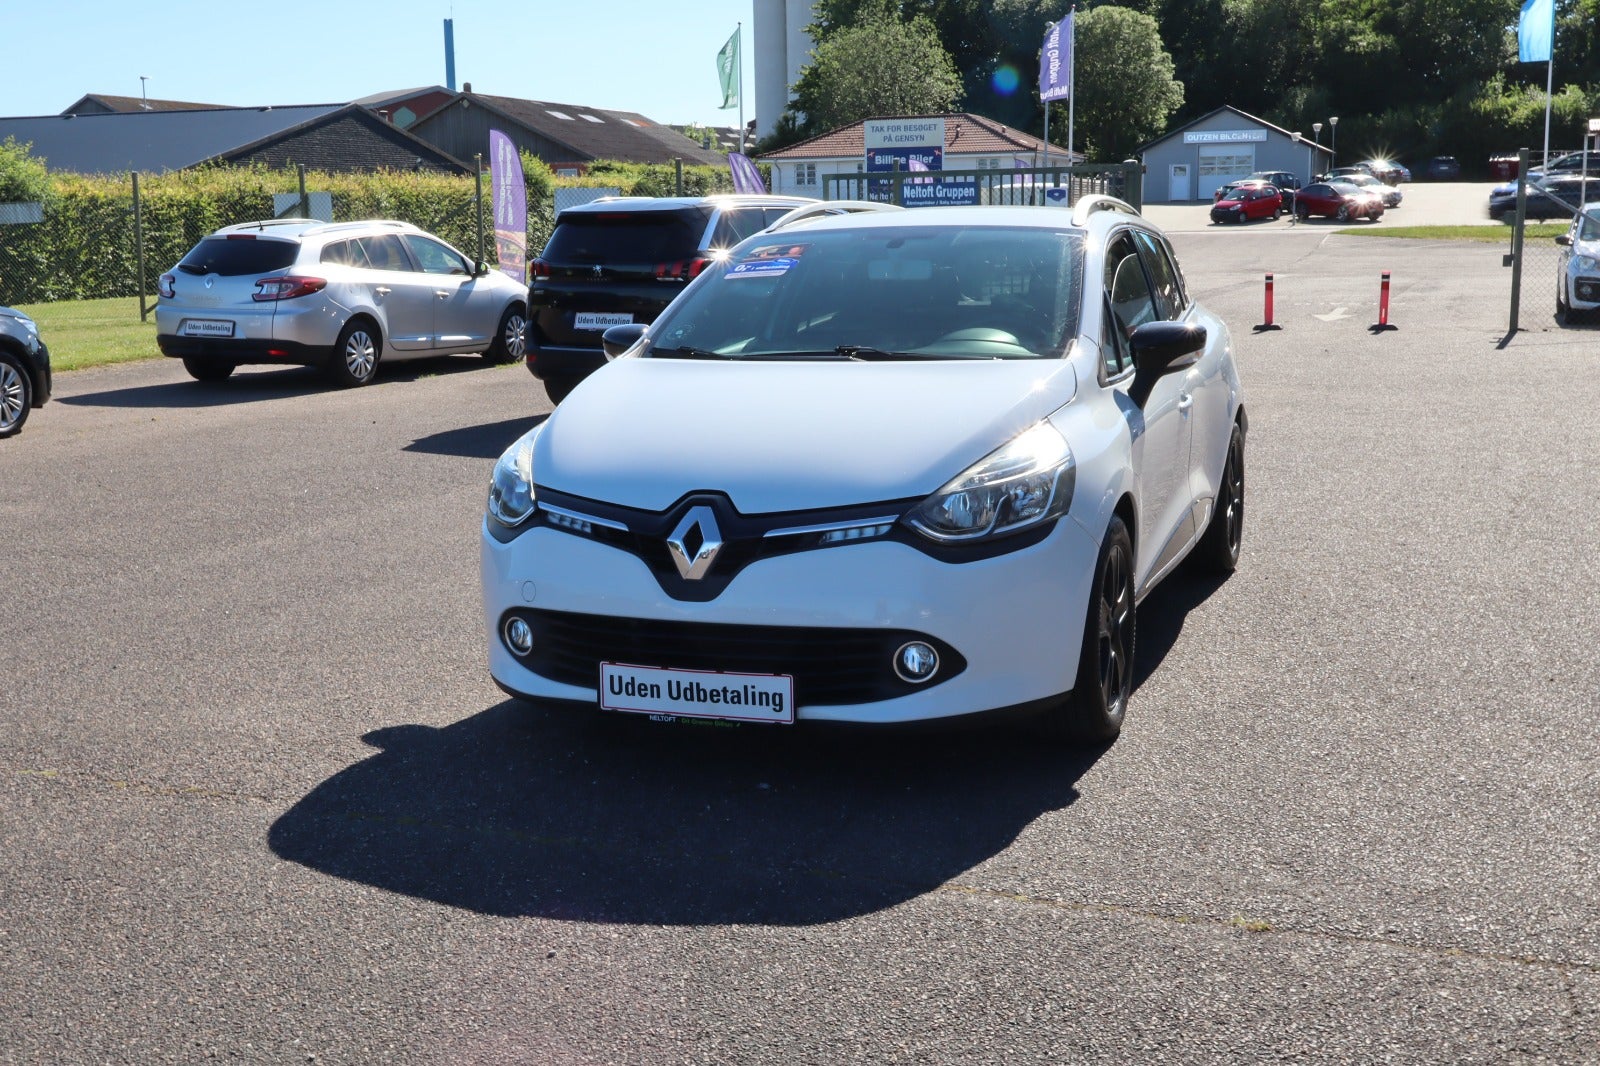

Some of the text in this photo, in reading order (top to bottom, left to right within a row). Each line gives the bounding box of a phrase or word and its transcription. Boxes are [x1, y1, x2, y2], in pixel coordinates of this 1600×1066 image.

[871, 125, 885, 133] TAK
[904, 123, 937, 132] BESØGET
[883, 134, 925, 143] PÅ GENSYN
[875, 154, 907, 165] Billie
[903, 185, 975, 199] Neltoft Gruppen
[577, 316, 631, 325] Uden Udbetaling
[202, 323, 231, 332] Udbetaling
[609, 674, 784, 713] Uden Udbetaling
[649, 714, 677, 723] NELTOFT
